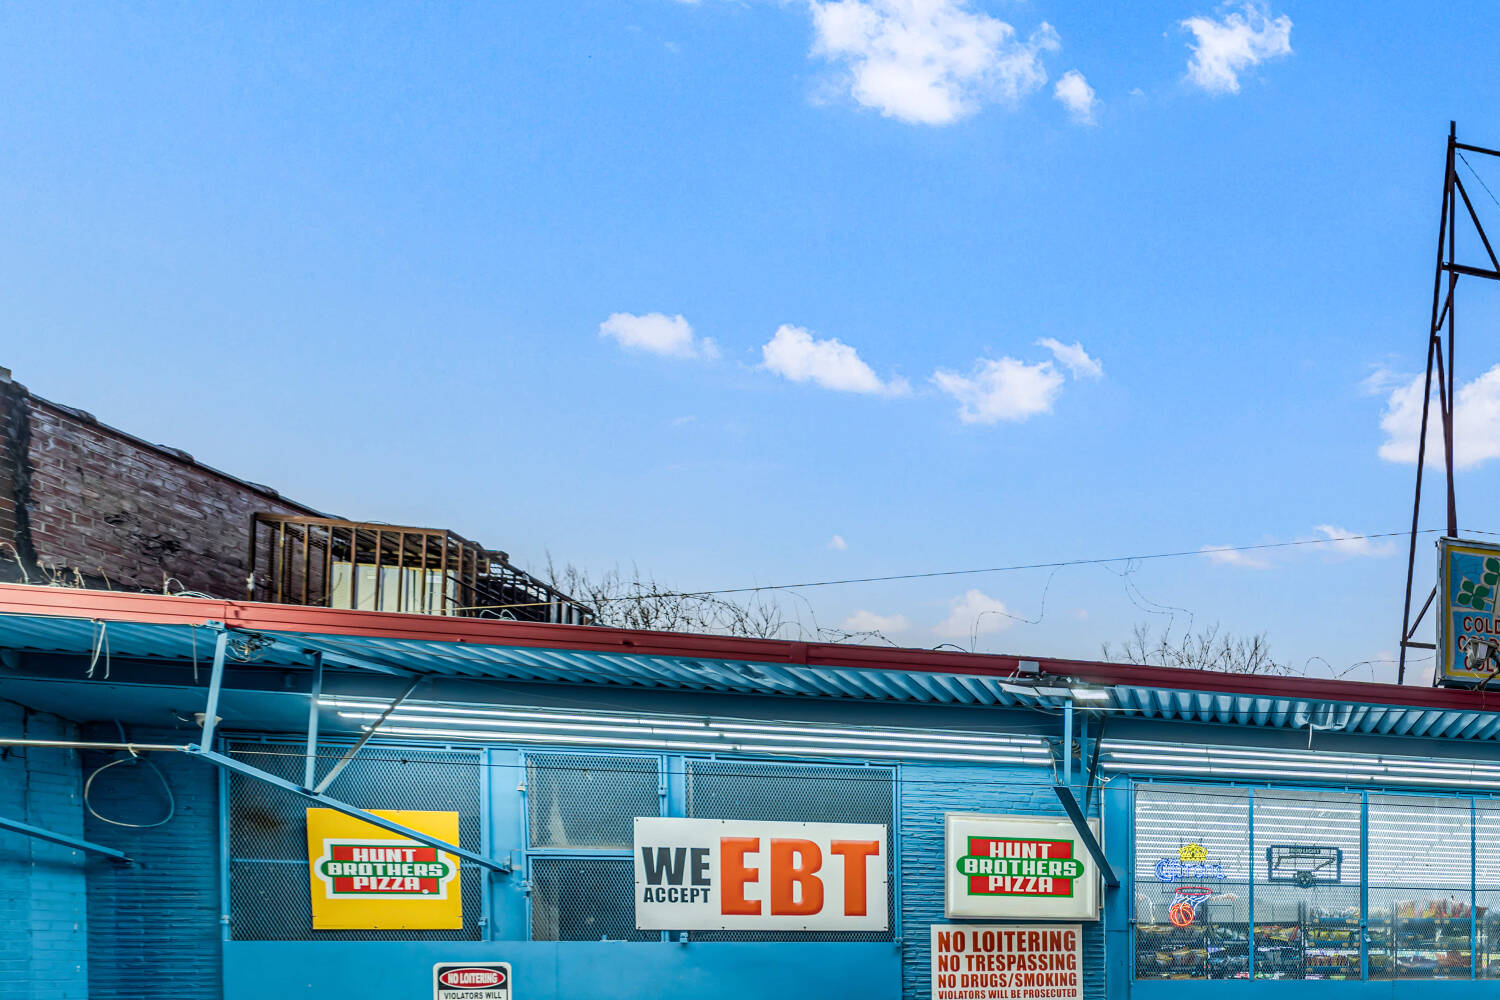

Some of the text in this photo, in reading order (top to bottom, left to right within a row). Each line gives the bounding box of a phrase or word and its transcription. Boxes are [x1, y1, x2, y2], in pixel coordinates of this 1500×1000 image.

[352, 848, 417, 863] HUNT
[989, 842, 1053, 859] HUNT
[327, 862, 443, 877] BROTHERS
[641, 846, 711, 886] WE
[964, 858, 1077, 876] BROTHERS
[1154, 858, 1227, 883] Corona
[353, 876, 420, 890] PIZZA
[720, 837, 880, 916] EBT
[988, 875, 1053, 893] PIZZA
[643, 887, 711, 903] ACCEPT
[937, 930, 1077, 953] NO LOITERING
[937, 953, 1077, 972] NO TRESPASSING
[448, 972, 498, 984] NO LOITERING
[938, 972, 1077, 989] NO DRUGS/SMOKING
[938, 988, 1077, 1000] VIOLATORS WILL BE PROSECUTED
